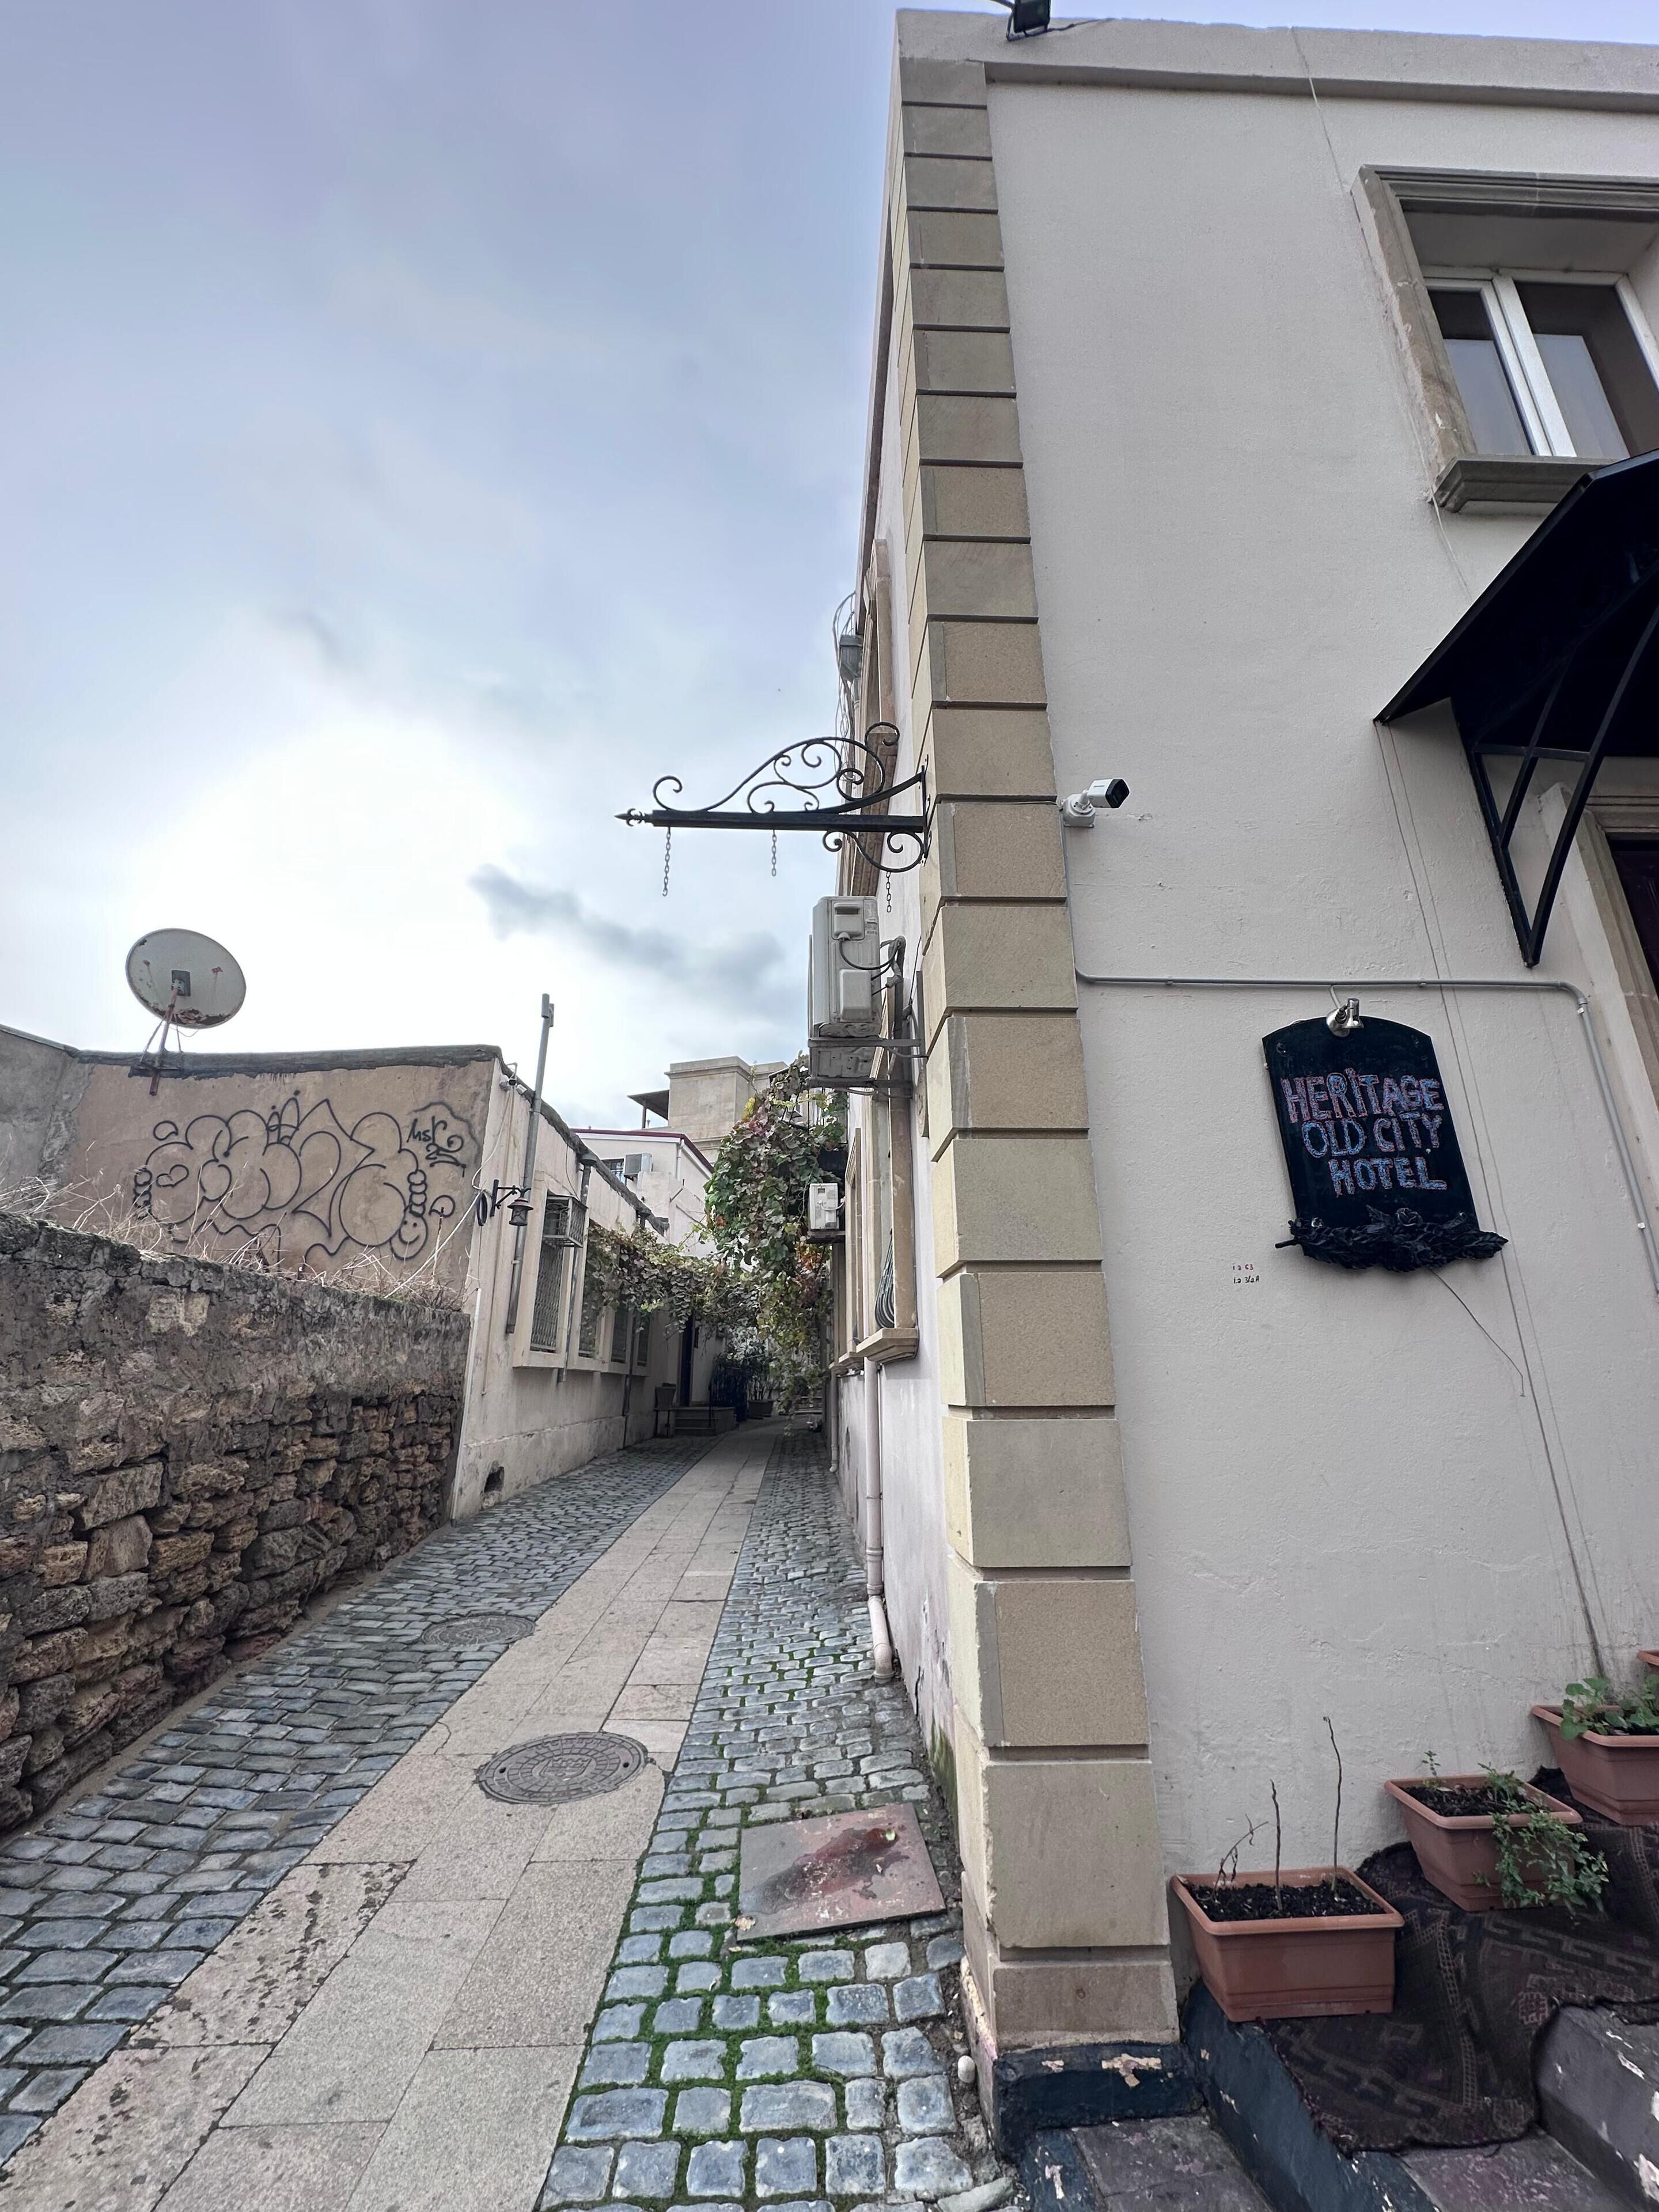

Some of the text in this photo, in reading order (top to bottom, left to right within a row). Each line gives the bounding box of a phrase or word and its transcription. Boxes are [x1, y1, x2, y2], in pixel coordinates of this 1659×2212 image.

[1301, 1111, 1442, 1158] OLD CITY
[1328, 1156, 1448, 1198] HOTEL
